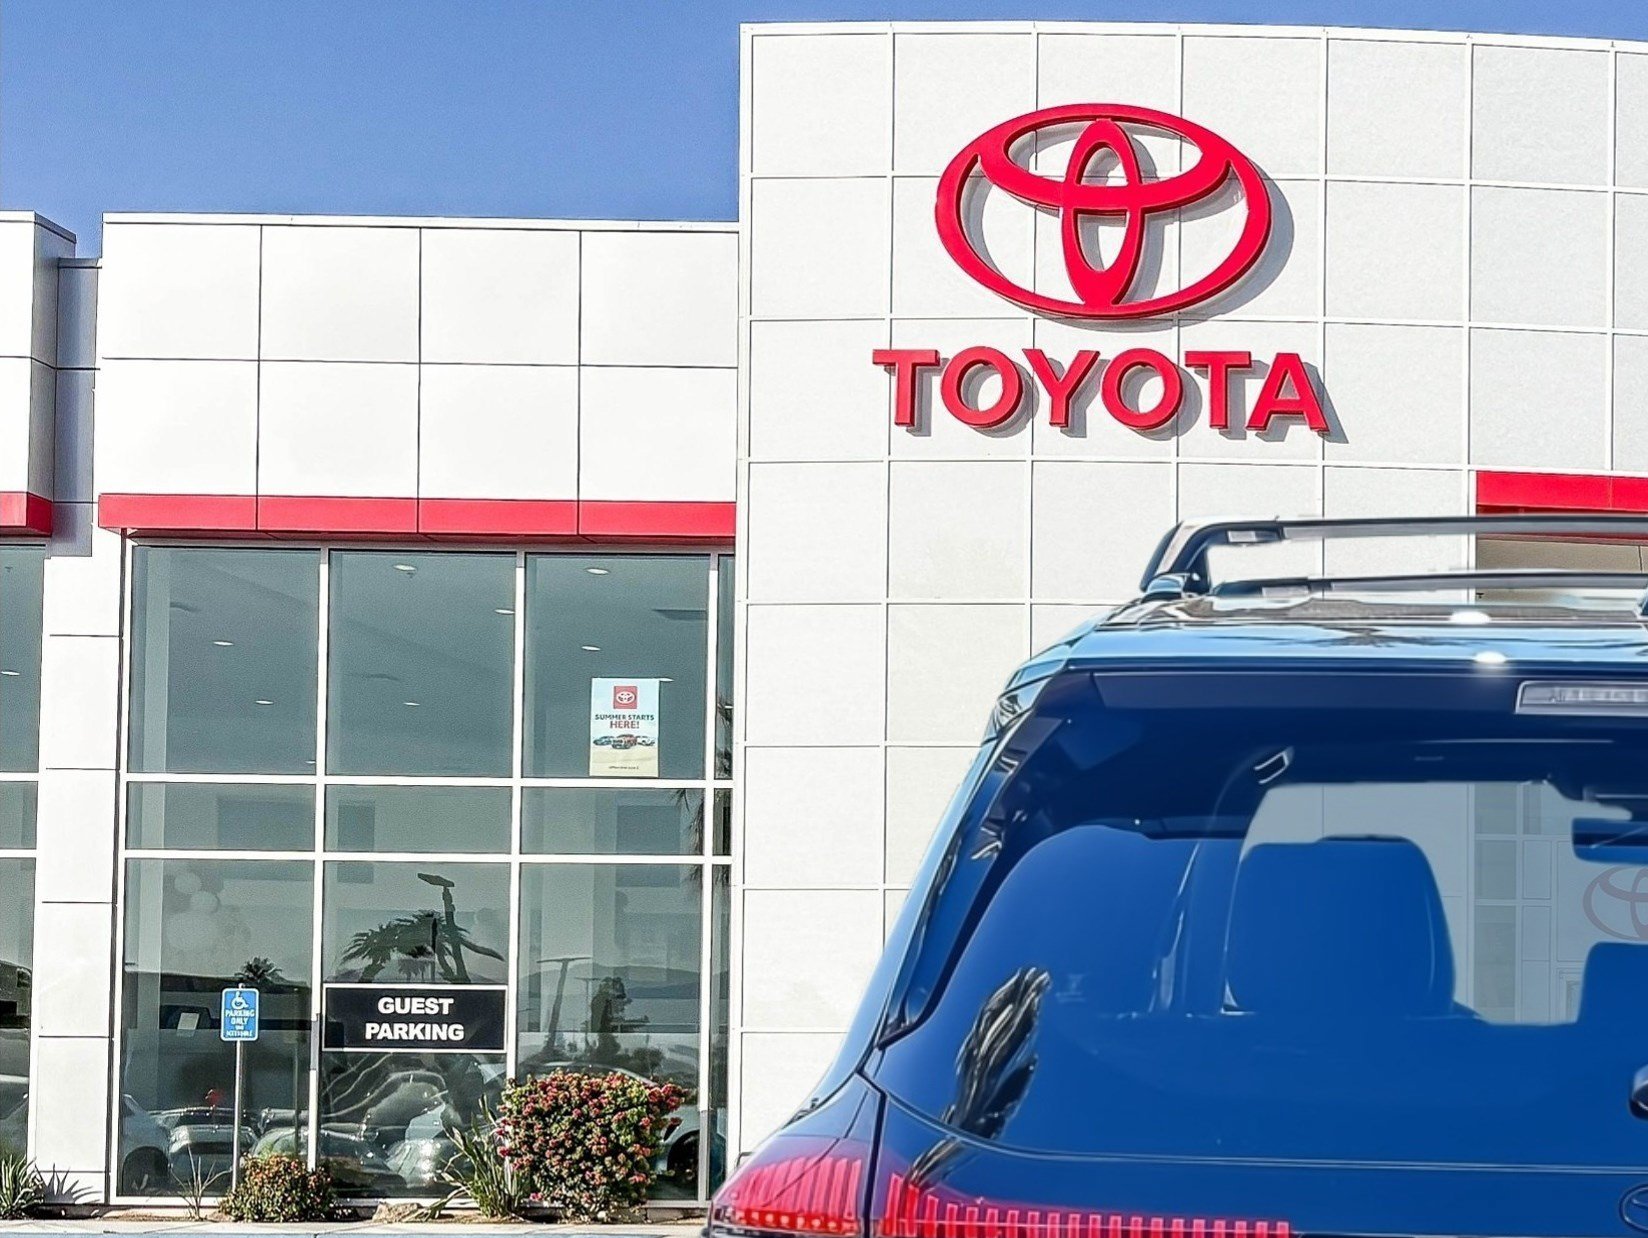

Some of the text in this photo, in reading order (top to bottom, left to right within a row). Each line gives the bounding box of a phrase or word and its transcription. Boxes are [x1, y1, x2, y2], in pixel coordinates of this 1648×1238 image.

[873, 346, 1329, 432] TOYOTA
[609, 720, 640, 729] HERE!
[225, 1009, 255, 1018] PARKING
[377, 997, 454, 1015] GUEST
[365, 1022, 465, 1041] PARKING
